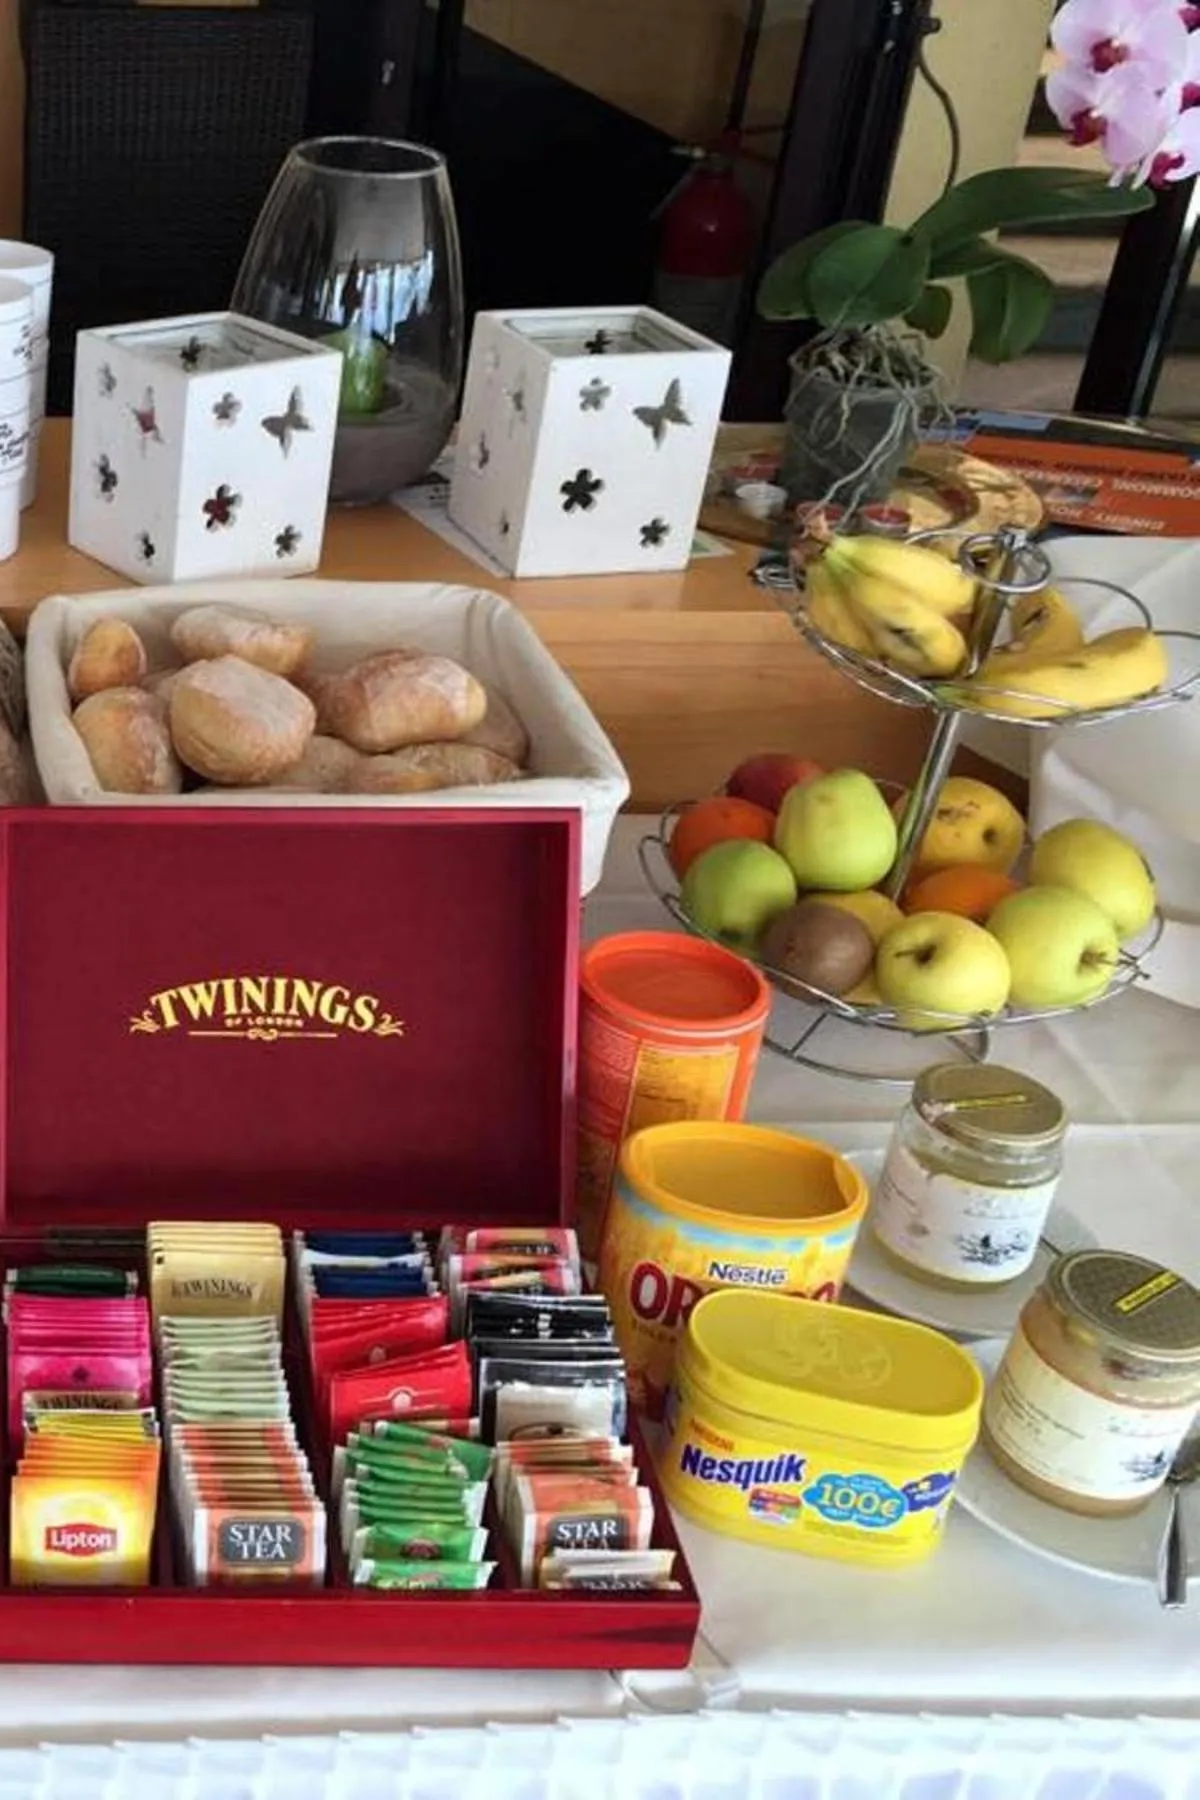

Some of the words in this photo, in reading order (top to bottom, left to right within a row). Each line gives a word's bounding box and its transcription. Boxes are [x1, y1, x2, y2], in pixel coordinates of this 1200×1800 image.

[150, 975, 380, 1033] TWININGS
[680, 1443, 806, 1491] Nesquik
[50, 1528, 112, 1551] Lipton
[228, 1522, 293, 1544] STAR
[555, 1519, 618, 1541] STAR
[237, 1541, 286, 1560] TEA
